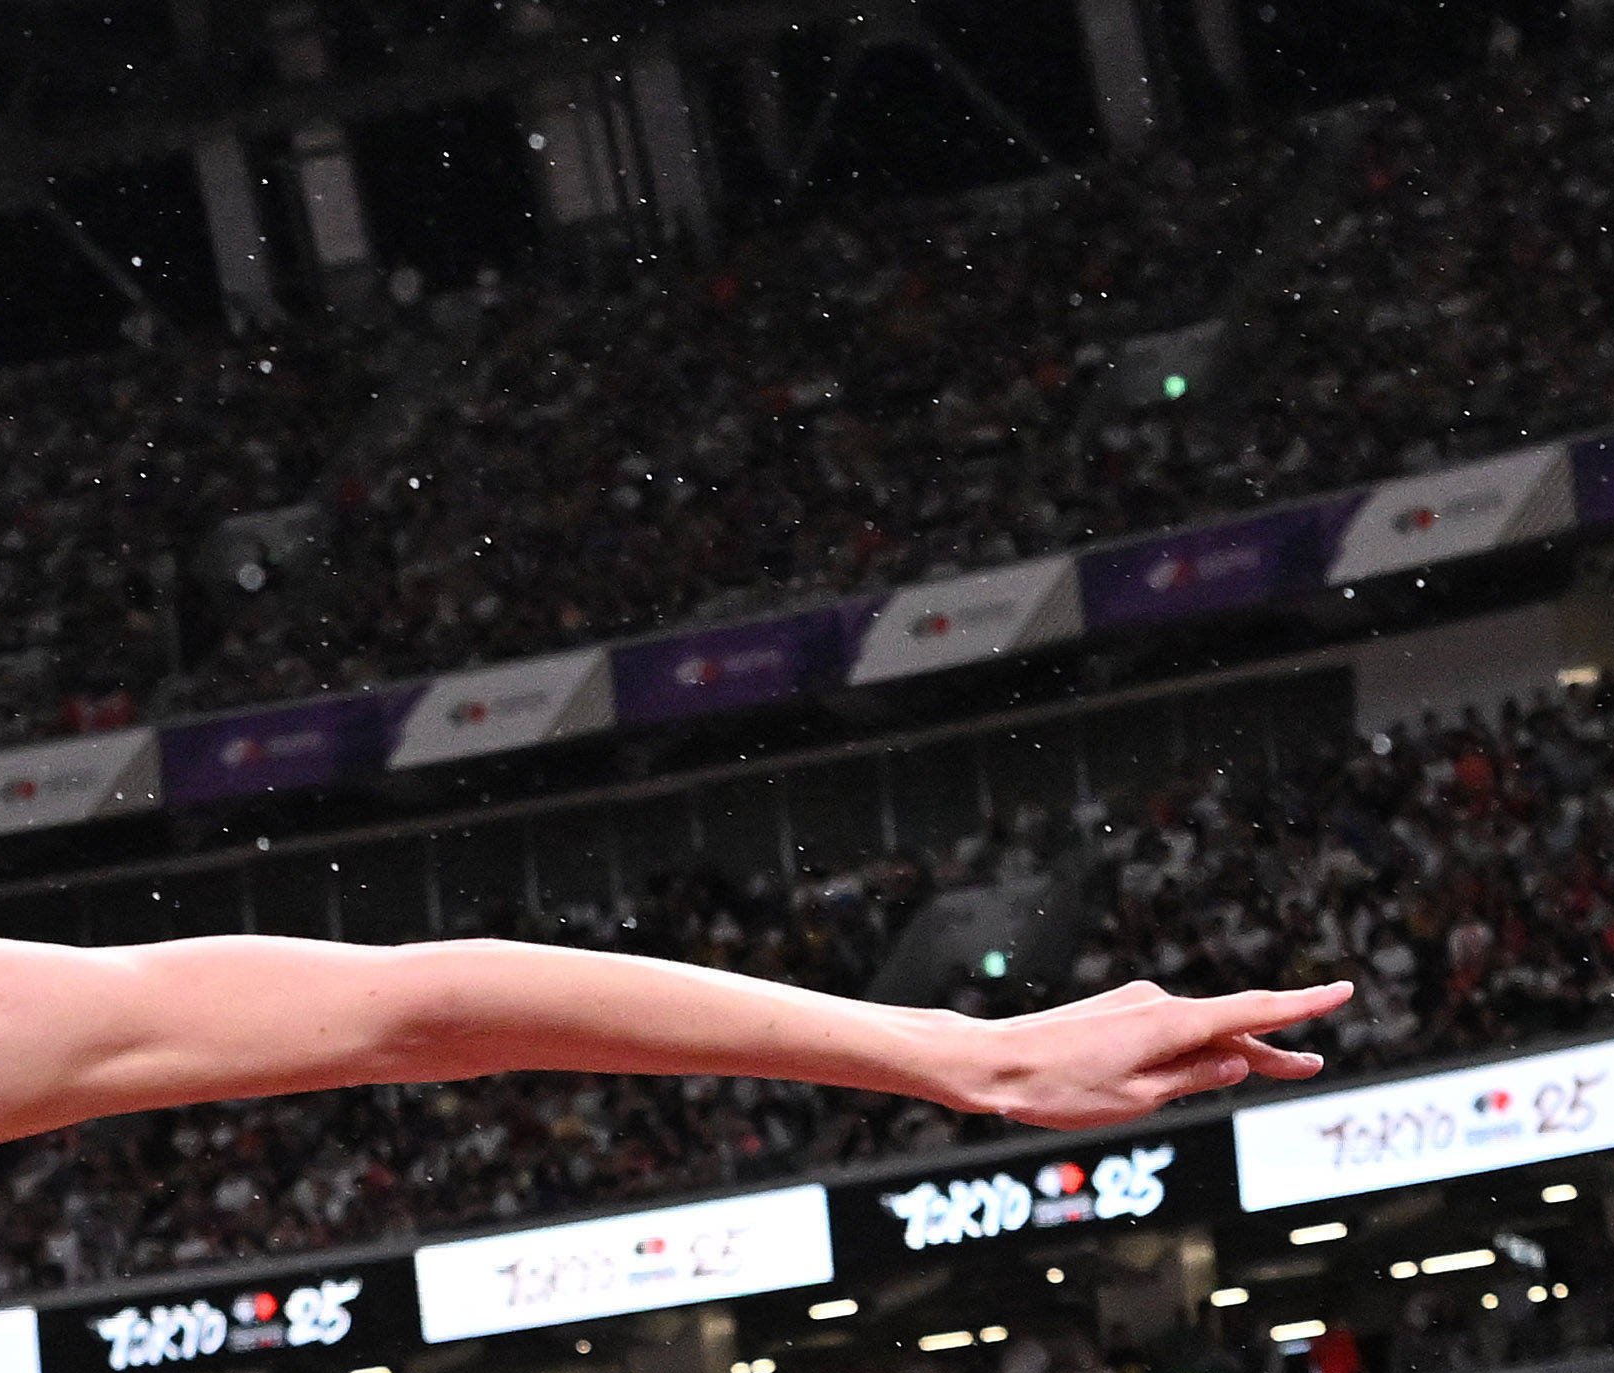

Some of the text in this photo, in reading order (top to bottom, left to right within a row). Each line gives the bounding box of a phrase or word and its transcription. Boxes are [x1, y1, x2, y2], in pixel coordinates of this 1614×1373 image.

[1317, 1071, 1608, 1168] TOKYO 25
[880, 1145, 1174, 1250] TOKYO 25
